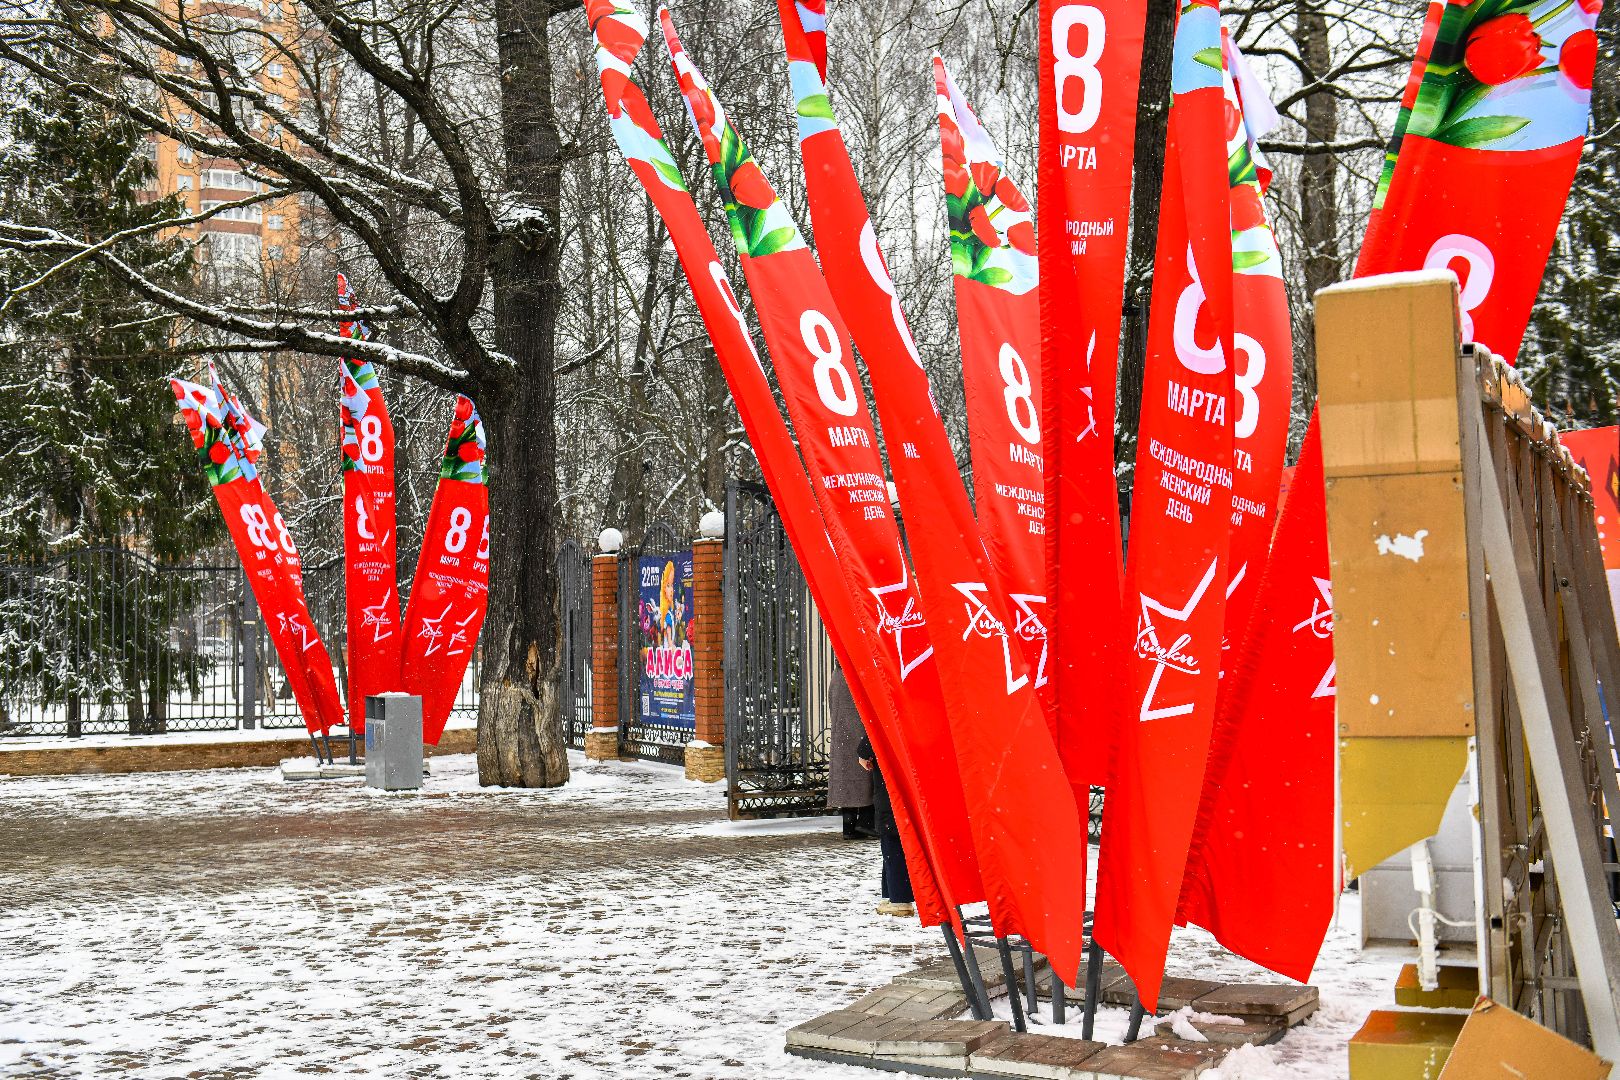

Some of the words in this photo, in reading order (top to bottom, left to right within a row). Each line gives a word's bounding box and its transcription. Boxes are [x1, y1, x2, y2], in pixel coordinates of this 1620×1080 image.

[1051, 4, 1106, 134] 8
[800, 309, 858, 417] 8
[998, 342, 1041, 445] 8
[1167, 380, 1226, 427] МАРТА
[361, 415, 384, 462] 8
[828, 426, 871, 449] МАРТА
[1160, 469, 1212, 506] ЖЕНСКИЙ
[445, 507, 472, 553] 8
[863, 505, 886, 520] ДЕНЬ
[1165, 497, 1193, 524] ДЕНЬ
[273, 512, 297, 555] 8
[641, 566, 651, 587] 22
[646, 646, 693, 680] АЛИСА
